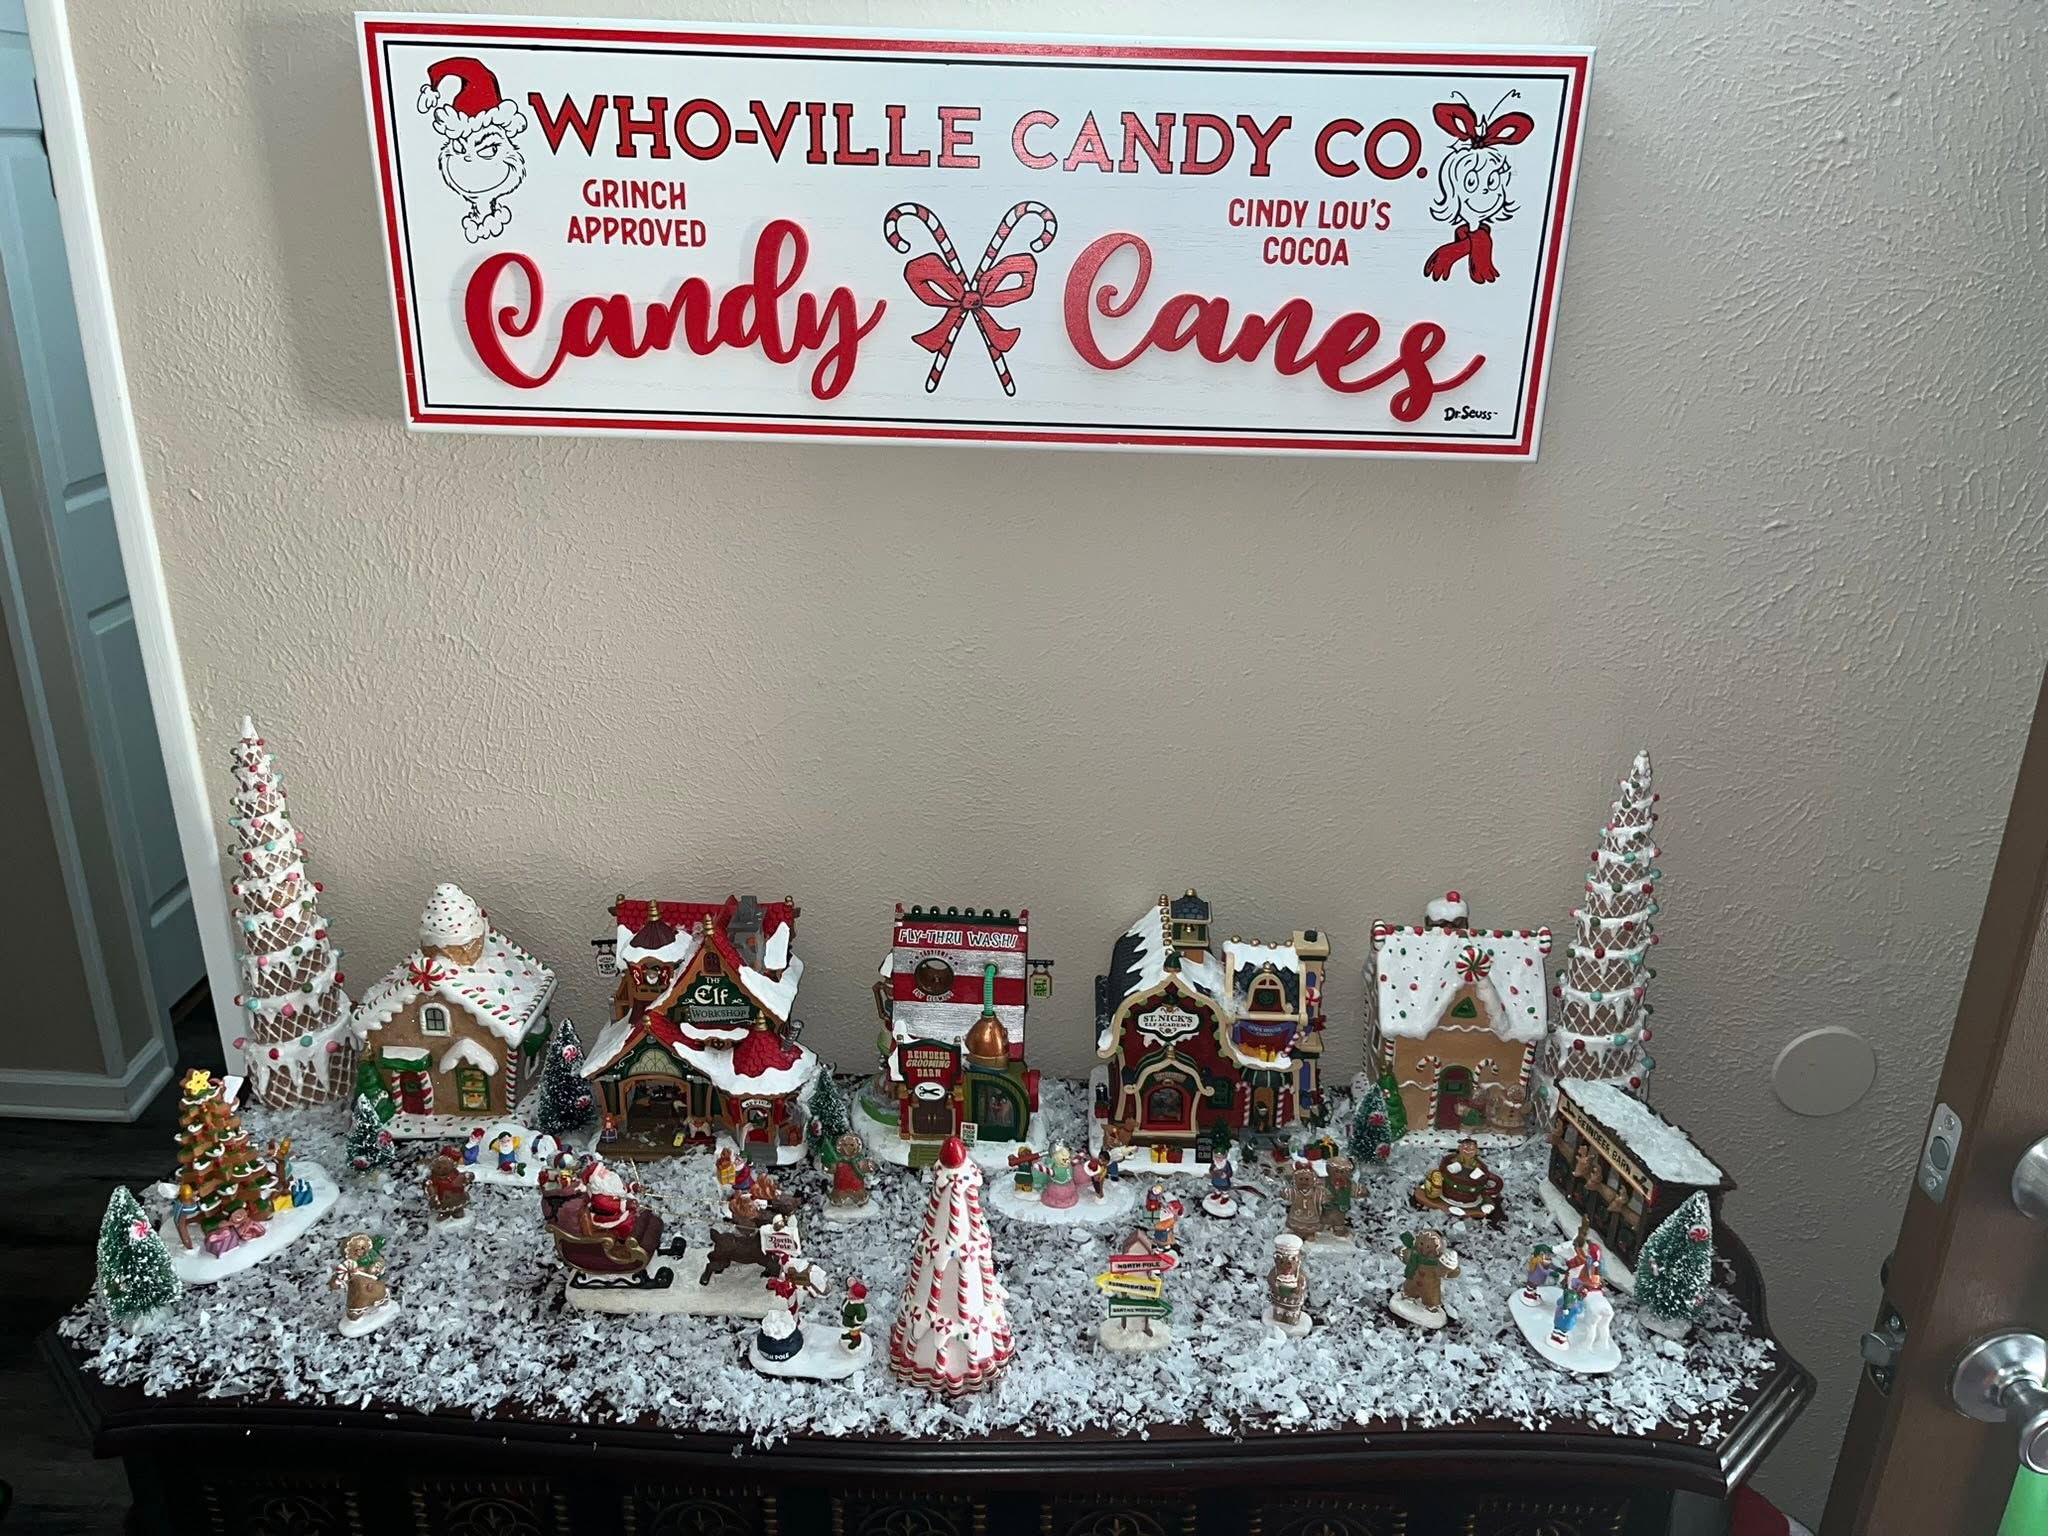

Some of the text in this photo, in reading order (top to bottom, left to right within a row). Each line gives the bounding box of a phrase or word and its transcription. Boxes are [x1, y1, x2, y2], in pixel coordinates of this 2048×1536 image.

[528, 92, 1428, 181] WHO-VILLE CANDY CO.
[582, 179, 686, 210] GRINCH
[1229, 198, 1391, 231] CINDY LOU'S
[567, 216, 707, 248] APPROVED
[1263, 236, 1349, 266] COCOA
[465, 219, 1486, 423] Candy Canes
[898, 928, 1019, 948] FLY-THRU WASH!
[694, 984, 729, 1005] Elf
[905, 1059, 952, 1069] GROOMING
[907, 1050, 951, 1060] REINDEER
[1611, 1150, 1632, 1176] BARN
[1142, 1261, 1161, 1269] POLE
